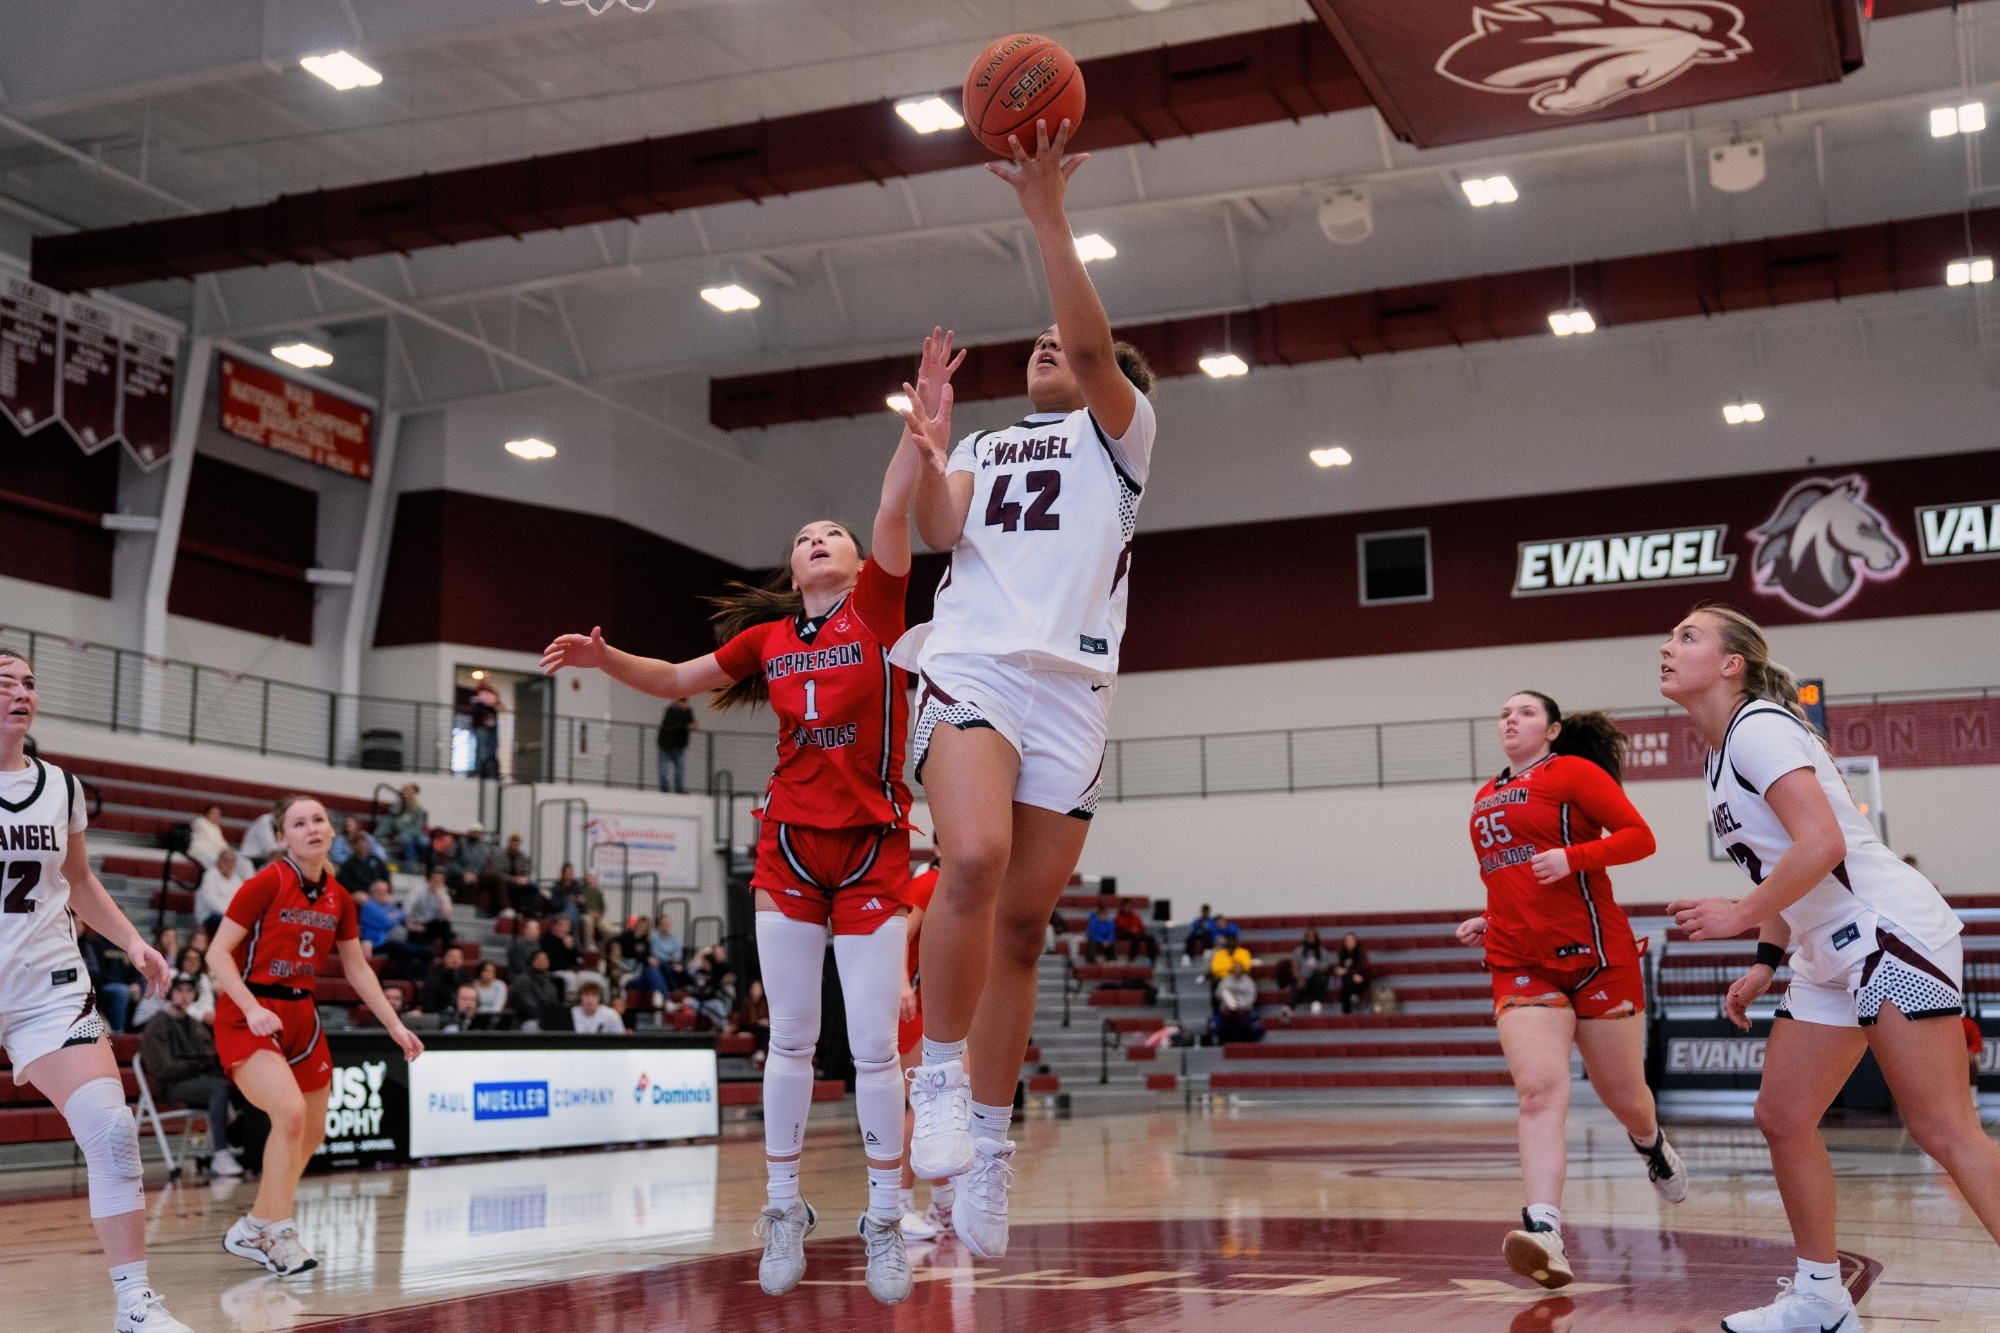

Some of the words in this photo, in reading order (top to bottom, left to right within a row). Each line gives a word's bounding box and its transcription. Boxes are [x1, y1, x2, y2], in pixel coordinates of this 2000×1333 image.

[1000, 54, 1056, 109] LEGACY
[985, 470, 1061, 533] 42
[1519, 529, 1726, 589] EVANGEL
[767, 641, 863, 681] MCPHERSON
[804, 678, 819, 721] 1
[790, 722, 857, 750] BULDOGS
[1474, 810, 1513, 849] 35
[1725, 842, 1769, 886] 2
[0, 860, 42, 913] 2
[1666, 1038, 1765, 1073] EVANG
[429, 1092, 468, 1112] PAUL
[476, 1088, 547, 1112] MUELLER
[553, 1086, 615, 1107] COMPANY
[325, 1107, 384, 1138] OPHY
